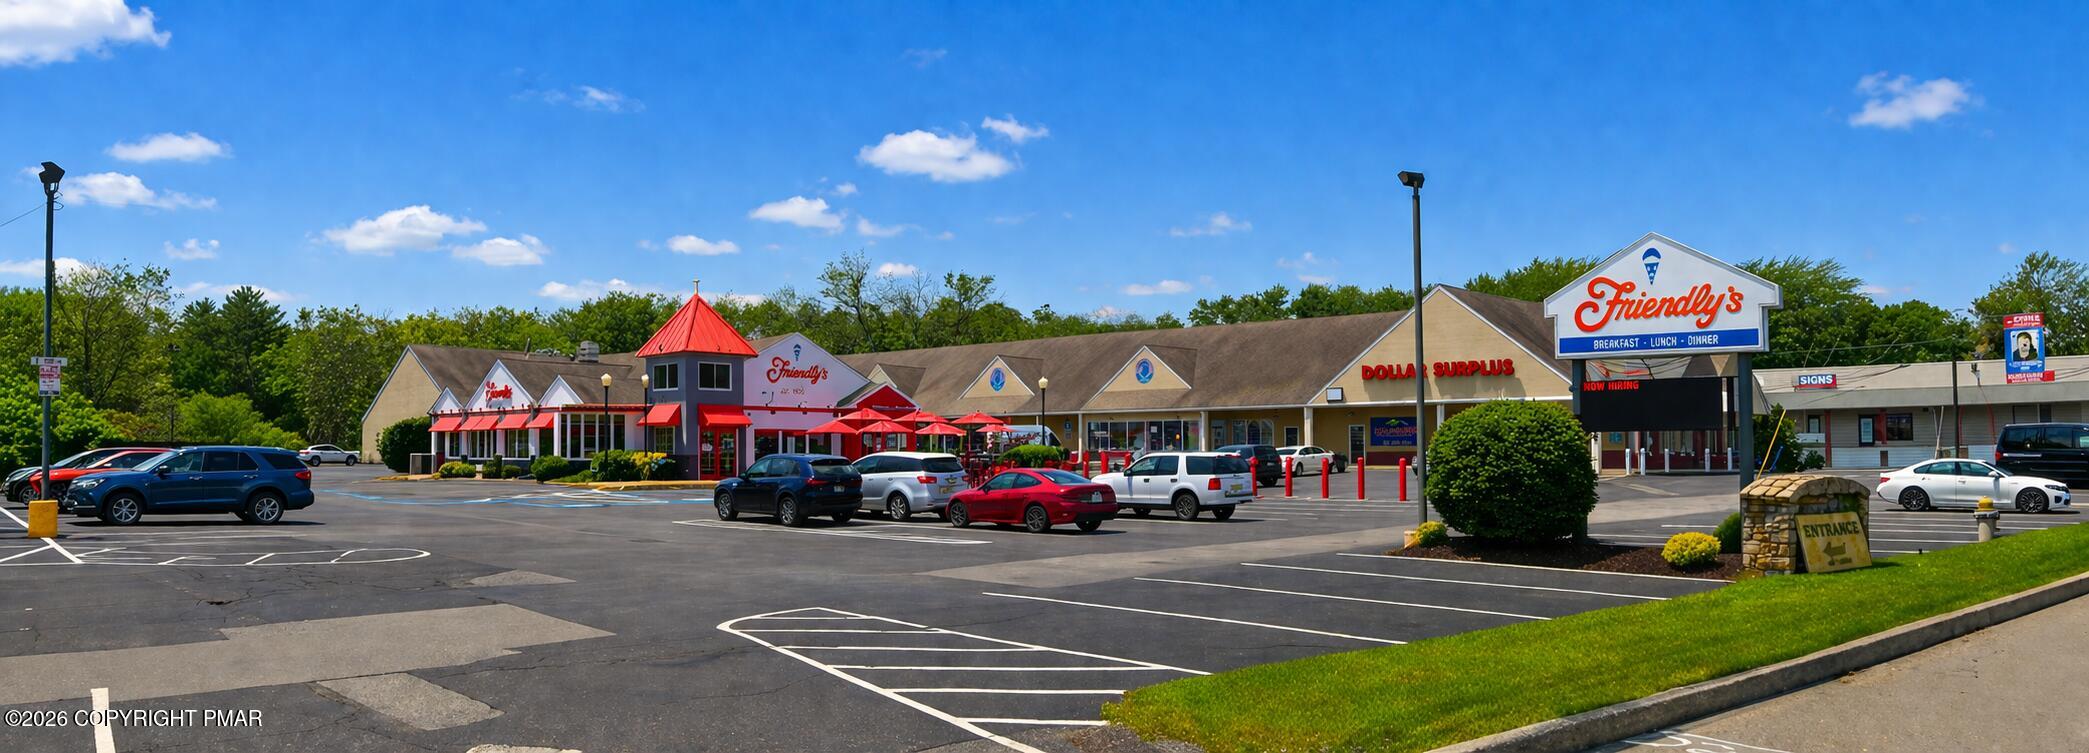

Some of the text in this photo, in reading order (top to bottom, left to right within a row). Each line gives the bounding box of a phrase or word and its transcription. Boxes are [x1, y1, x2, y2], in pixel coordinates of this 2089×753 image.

[1574, 277, 1744, 332] Friendly's
[1593, 337, 1640, 349] BREAKFAST
[1650, 336, 1677, 347] LUNCH
[1687, 334, 1719, 345] DINNER
[766, 356, 828, 385] Friendly's
[1433, 358, 1515, 378] SURPLUS
[1583, 380, 1639, 391] NOW HIRING
[1800, 375, 1833, 384] SIGNS
[1803, 521, 1860, 538] ENTRANCE
